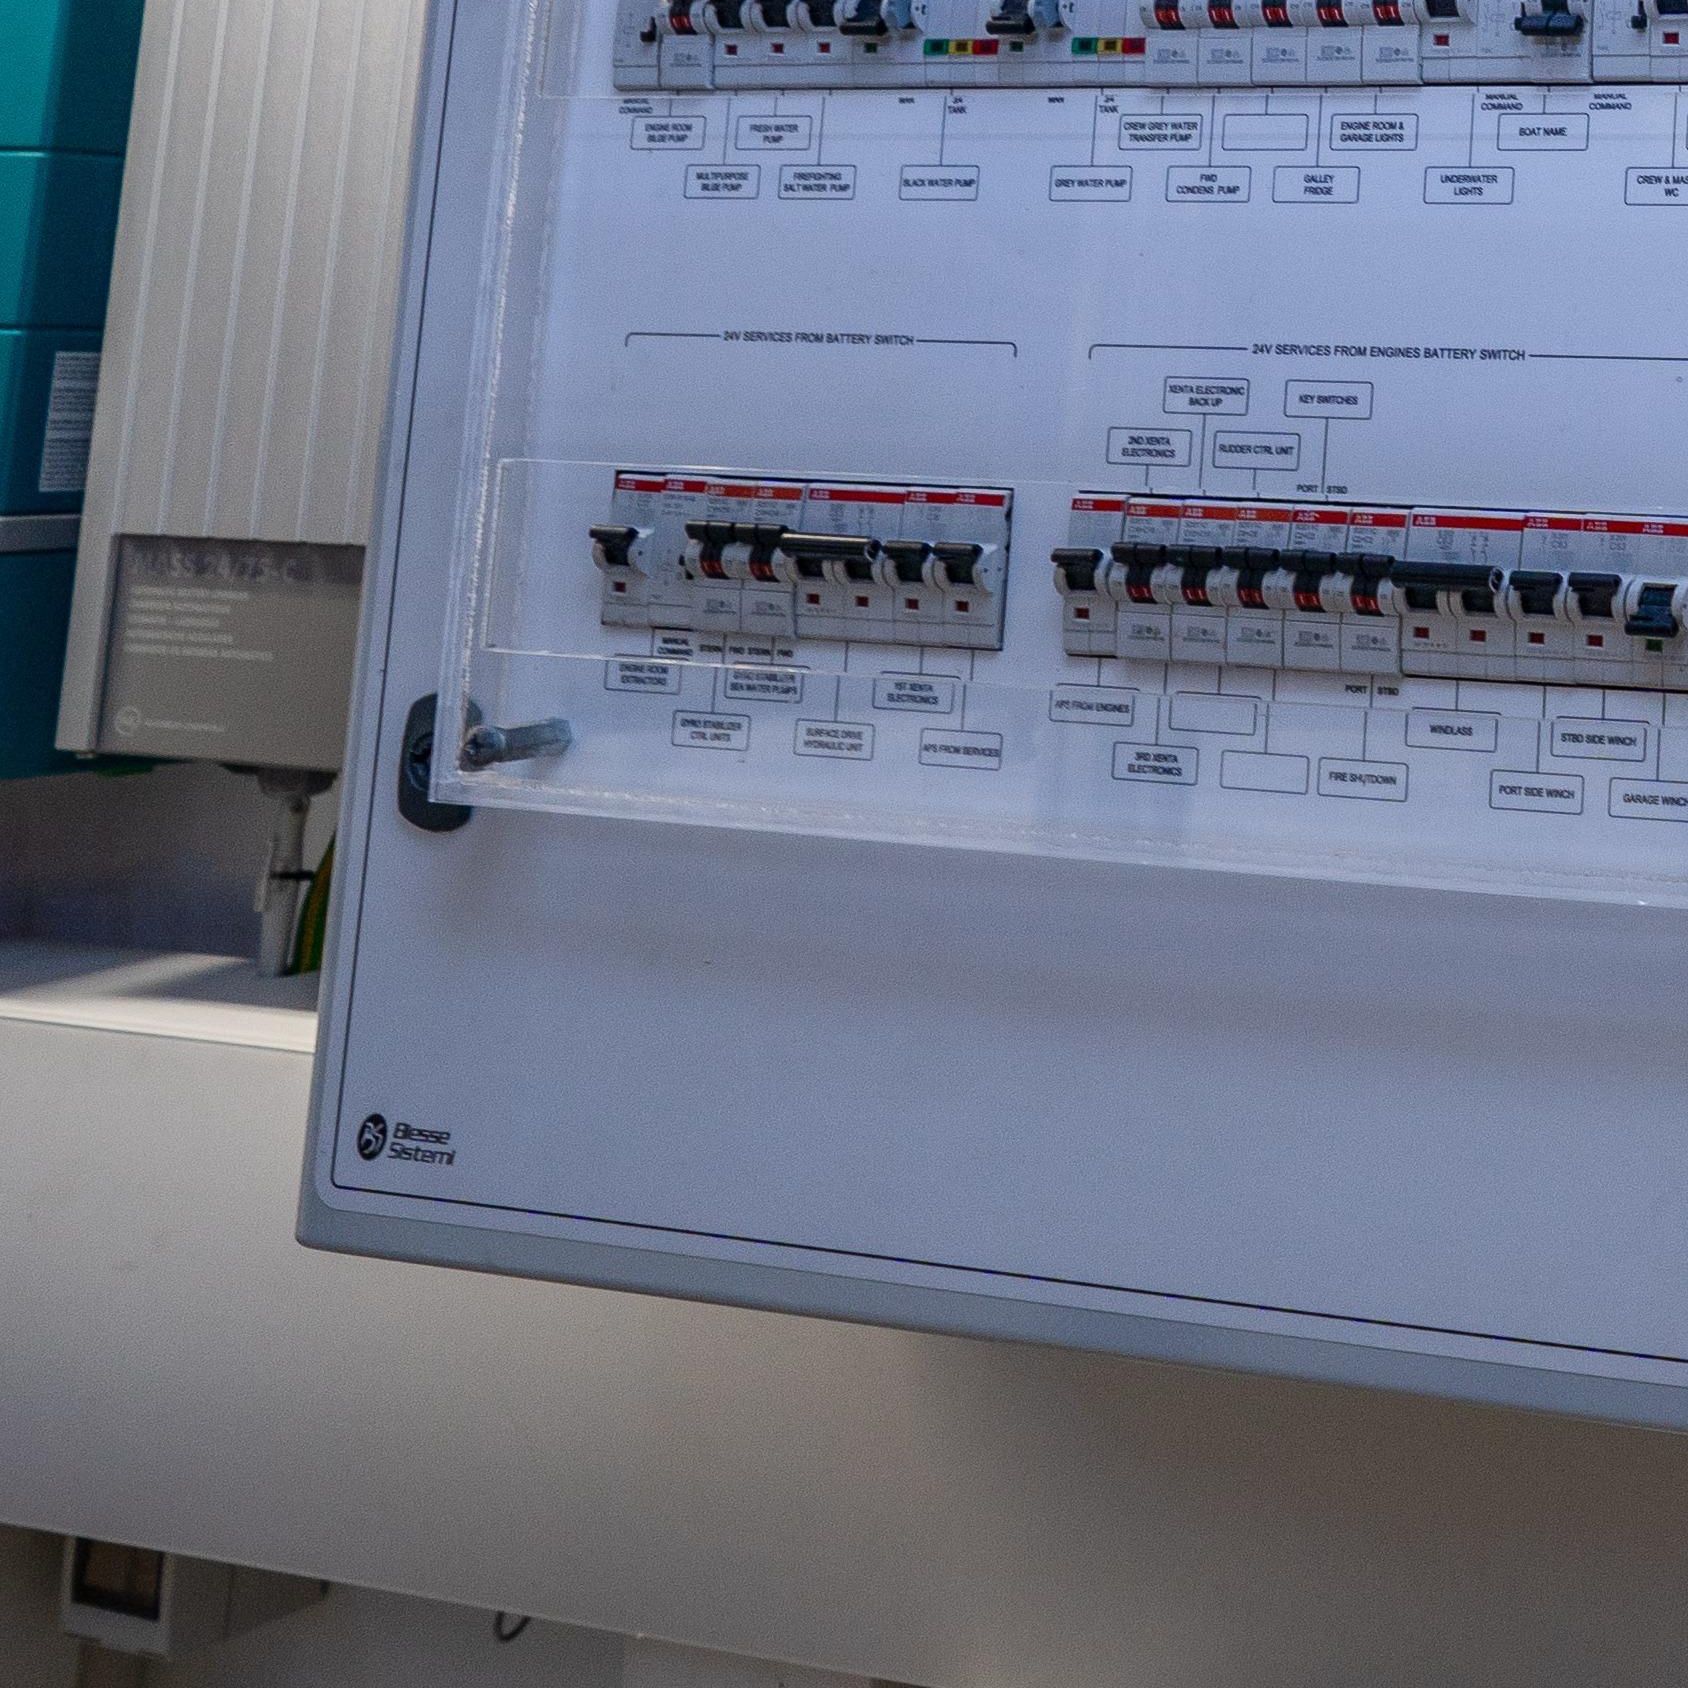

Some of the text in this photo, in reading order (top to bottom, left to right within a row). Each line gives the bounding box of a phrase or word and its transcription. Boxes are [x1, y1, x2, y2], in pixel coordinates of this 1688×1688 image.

[1252, 344, 1525, 361] 24V SERVICES FROM ENGINES BATTERY SWITCH
